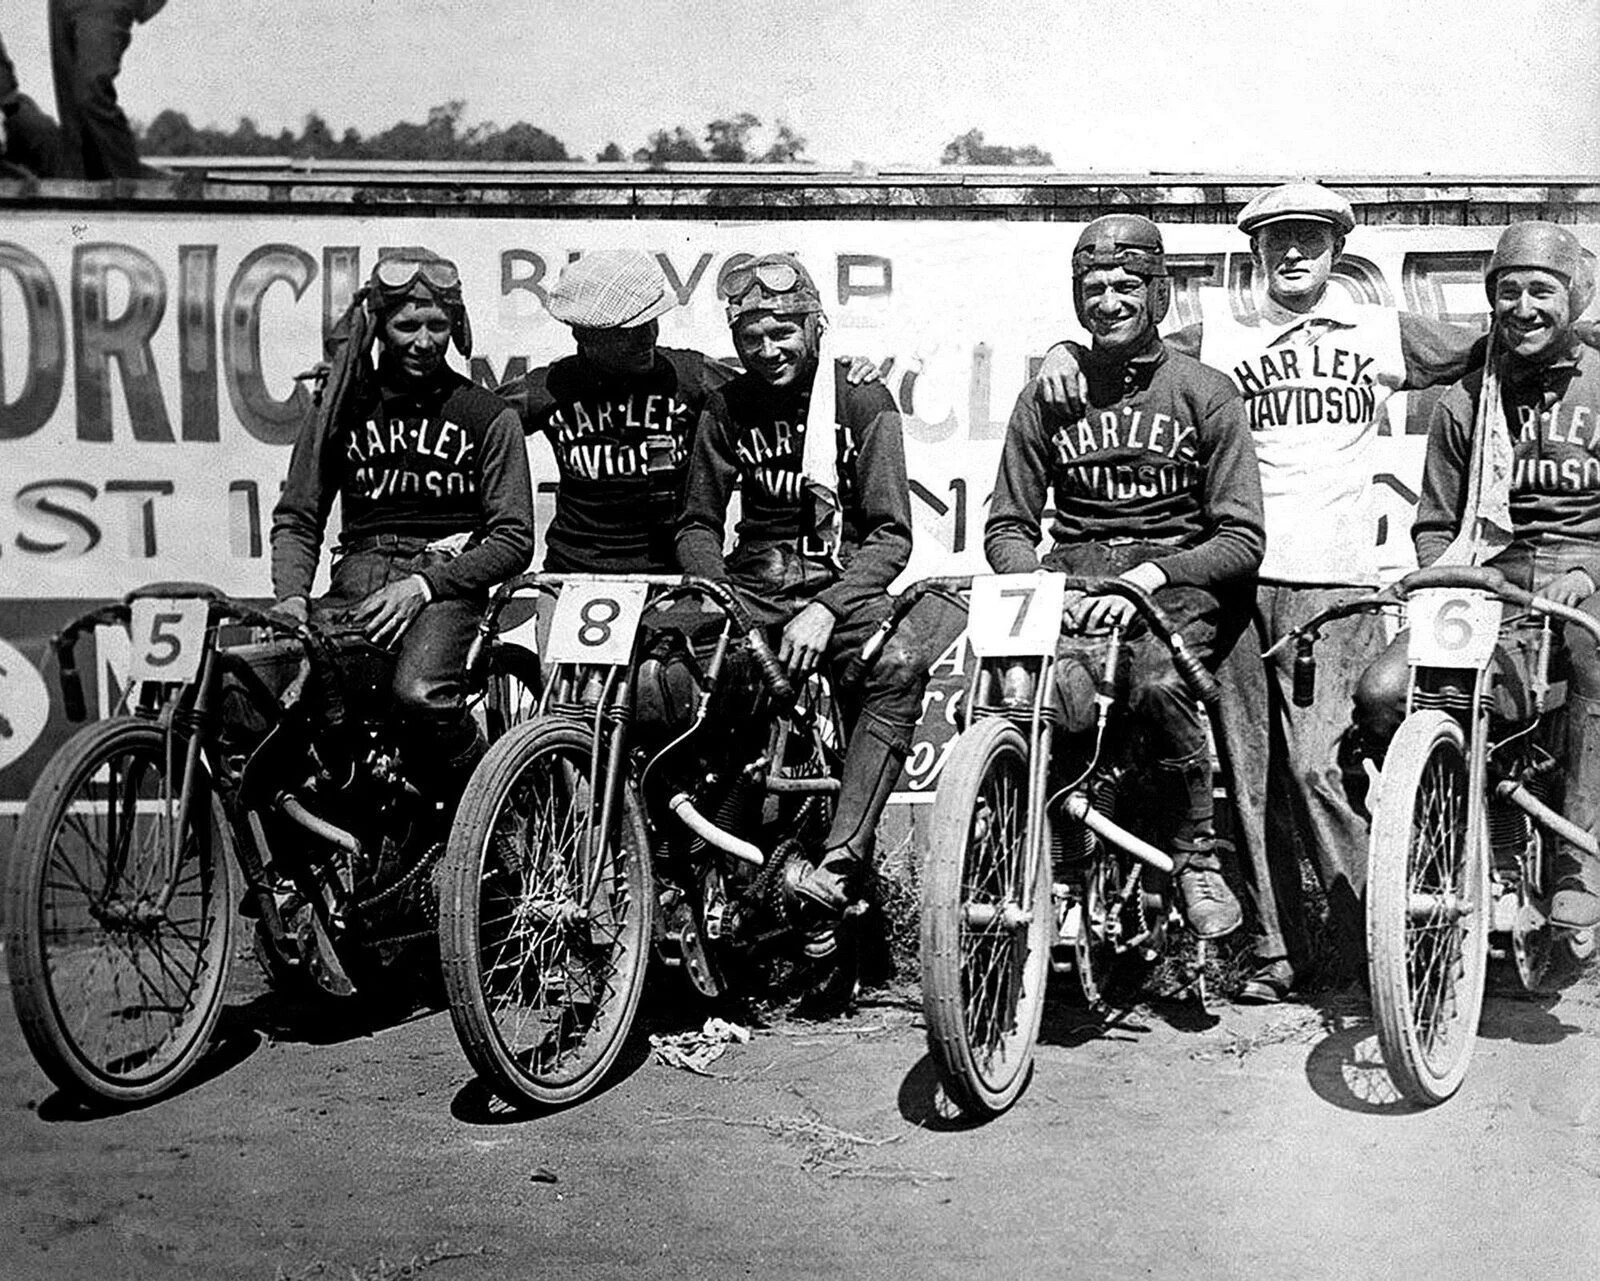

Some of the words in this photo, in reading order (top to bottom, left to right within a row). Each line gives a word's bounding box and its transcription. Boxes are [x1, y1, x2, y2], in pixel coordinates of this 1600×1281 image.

[0, 479, 175, 561] ST
[578, 598, 621, 647] 8
[1000, 588, 1036, 637] 7
[1433, 599, 1472, 651] 6
[145, 613, 183, 667] 5
